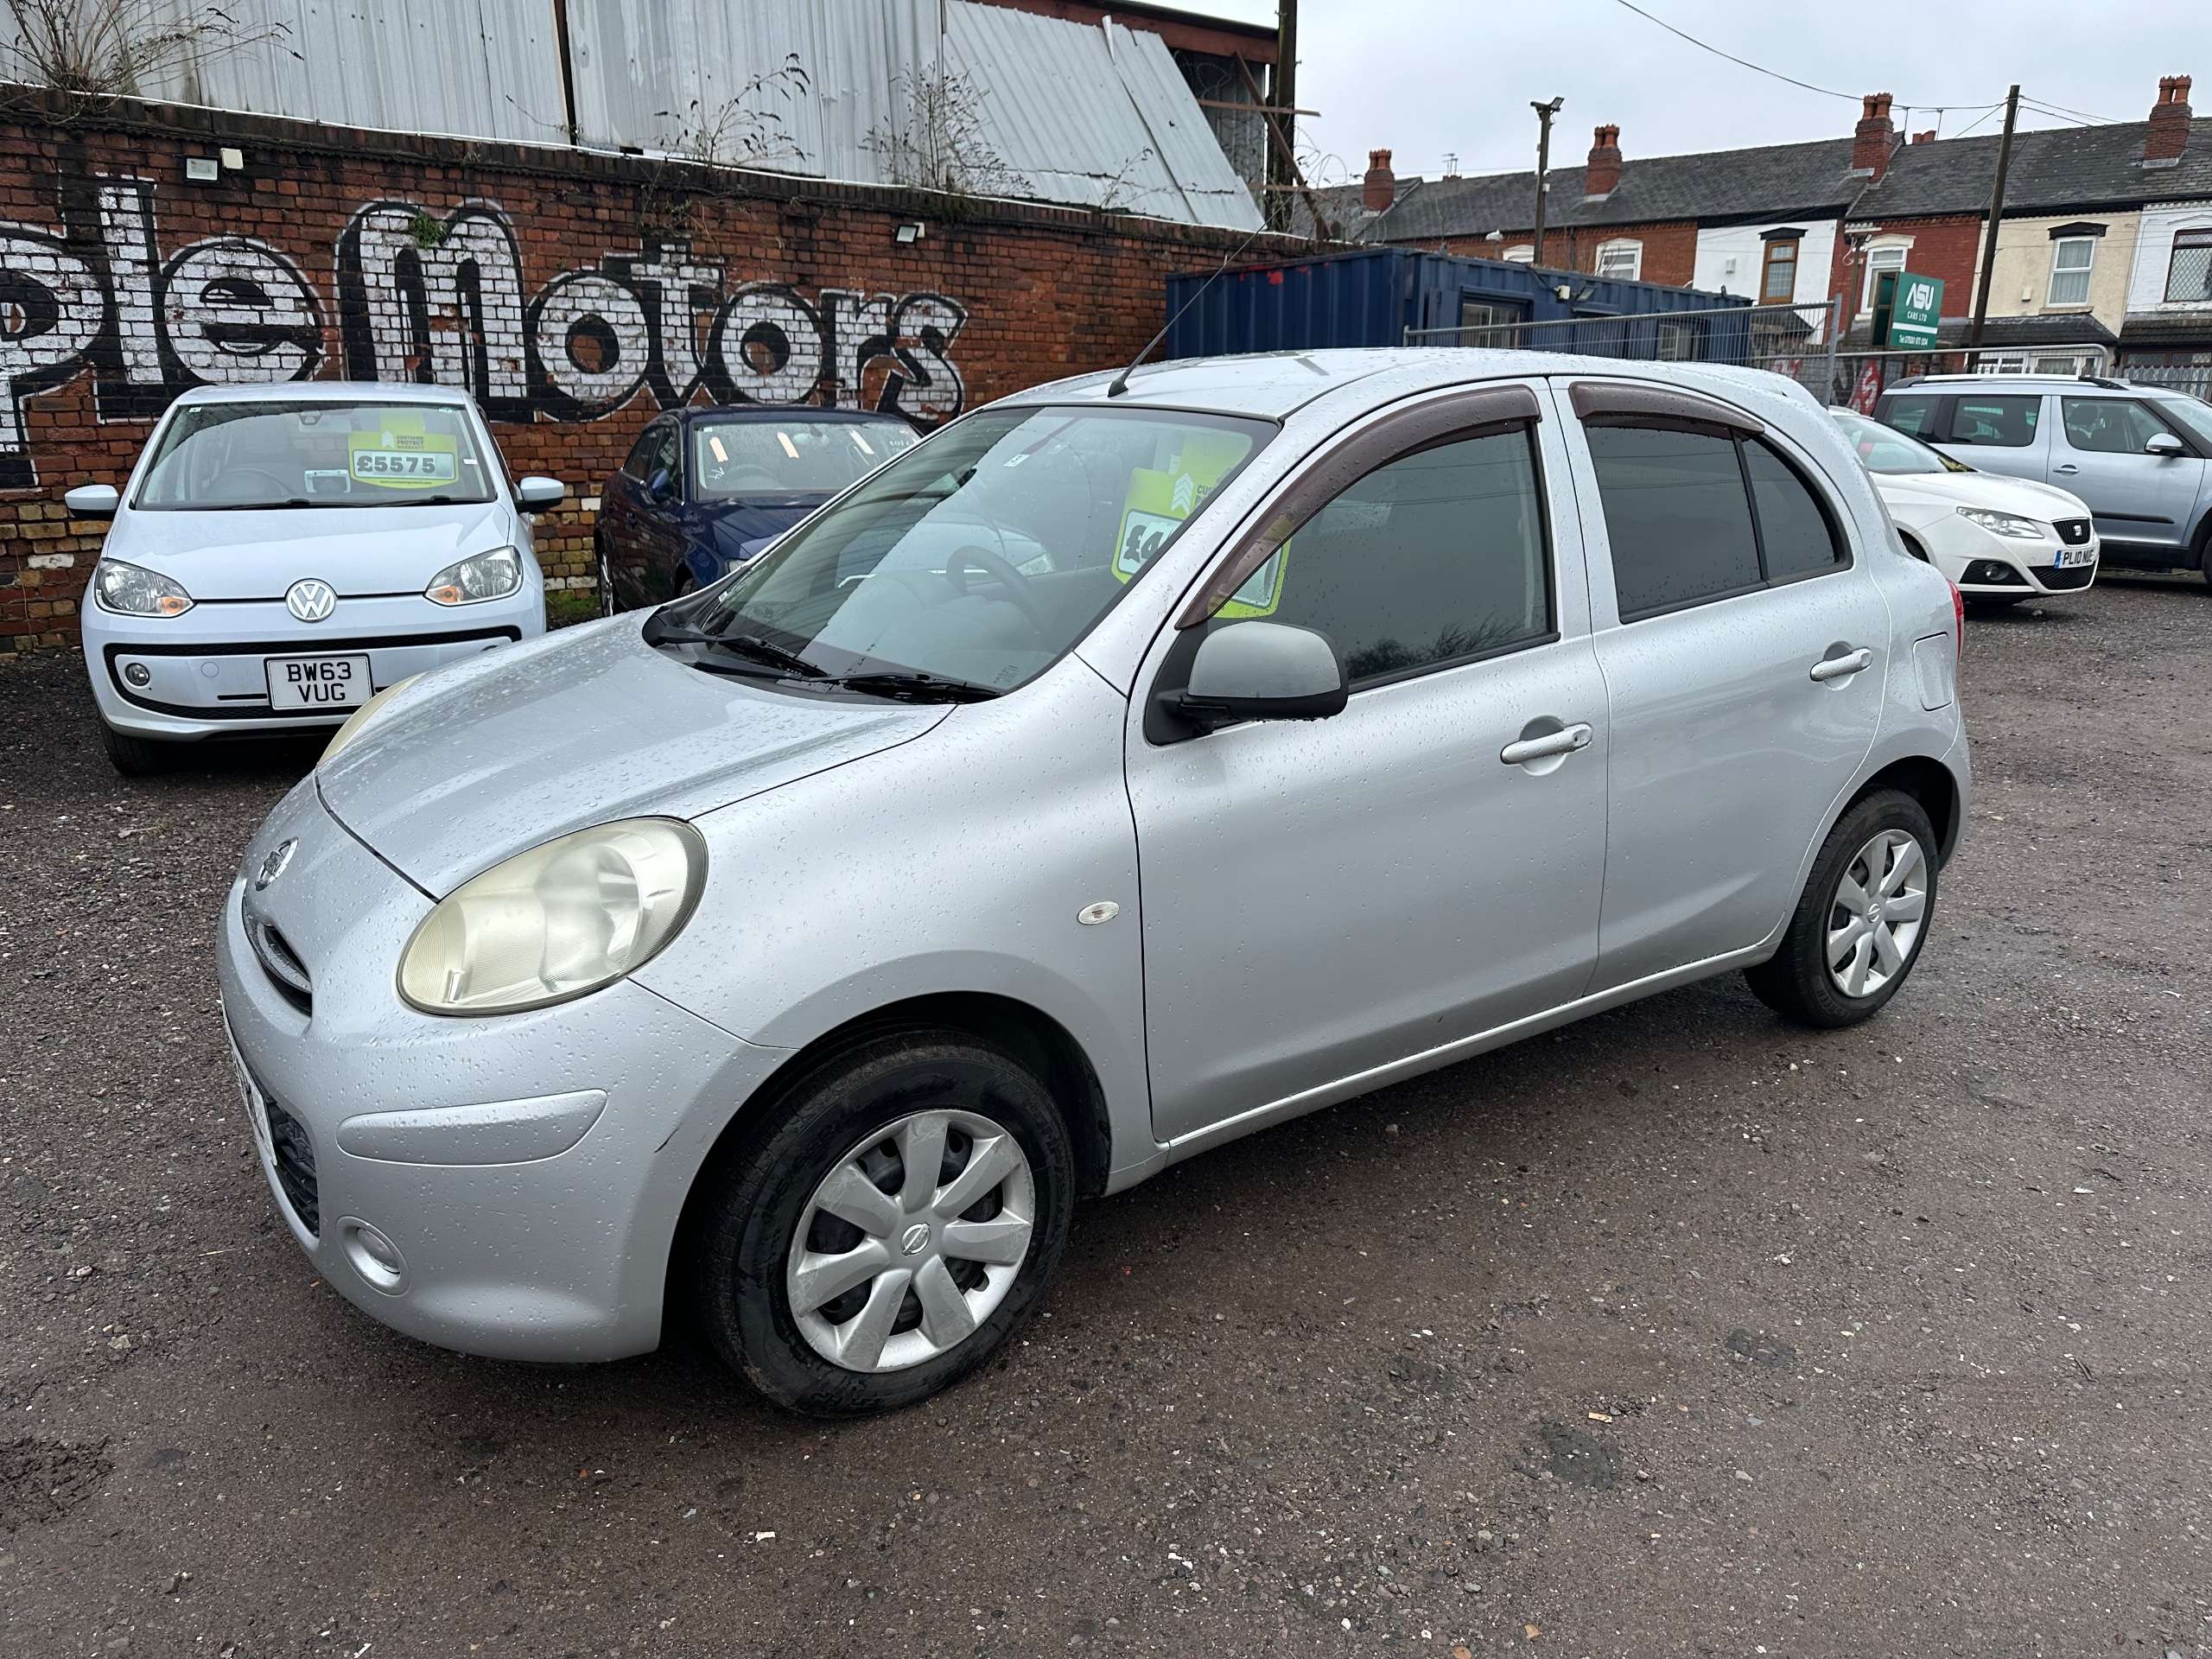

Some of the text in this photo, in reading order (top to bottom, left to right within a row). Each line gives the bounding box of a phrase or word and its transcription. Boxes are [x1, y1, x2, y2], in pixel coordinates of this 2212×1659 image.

[339, 199, 966, 426] Motors
[1907, 311, 1919, 321] CARS
[356, 455, 435, 474] £5575
[2063, 550, 2082, 566] PL10
[286, 661, 352, 682] BW63
[297, 683, 346, 702] VUG
